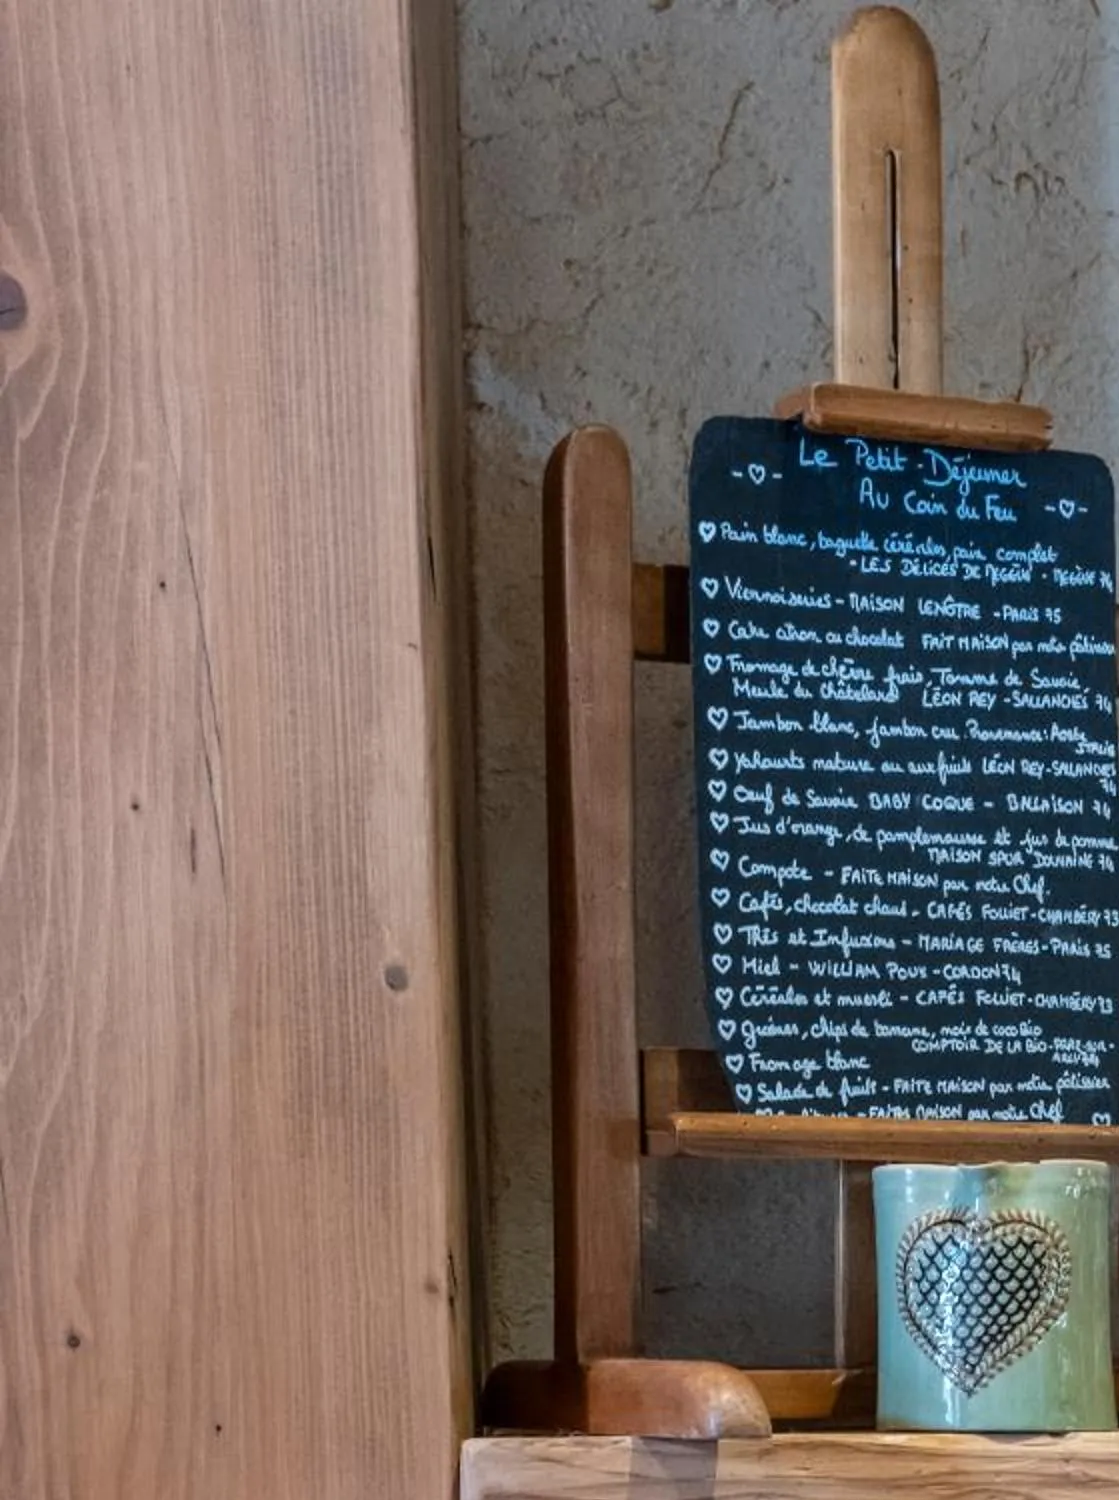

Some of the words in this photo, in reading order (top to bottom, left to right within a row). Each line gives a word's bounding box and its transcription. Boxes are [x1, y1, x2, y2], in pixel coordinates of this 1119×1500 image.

[799, 436, 839, 467] Le
[859, 476, 890, 509] Au
[903, 489, 947, 515] Coin
[956, 496, 980, 520] du
[985, 494, 1017, 522] Feu
[720, 520, 758, 543] Pain
[817, 530, 879, 557] baguette
[996, 541, 1060, 571] complet
[962, 563, 981, 580] DE
[723, 575, 832, 610] Viennoiseries
[849, 592, 905, 615] MAISON
[918, 594, 982, 621] LENÔTRE
[1044, 607, 1062, 625] 75
[728, 620, 770, 640] Cake
[825, 631, 844, 644] ou
[845, 625, 905, 649] chocolat
[921, 632, 955, 651] FAIT
[957, 632, 1009, 651] MAISON
[1011, 640, 1034, 660] par
[726, 653, 799, 685] Fromage
[802, 658, 820, 678] de
[930, 667, 999, 687] Tomme
[1004, 668, 1023, 686] de
[731, 676, 789, 700] Meule
[793, 681, 813, 699] du
[819, 680, 900, 704] Châtelard
[921, 687, 962, 709] LÉON
[969, 691, 997, 712] REY
[1095, 692, 1113, 715] 74
[733, 710, 804, 732] Jambon
[865, 715, 928, 749] jambon
[812, 751, 876, 773] nature
[880, 762, 905, 774] ou
[981, 752, 1015, 775] LÉON
[781, 786, 801, 806] de
[805, 787, 859, 810] Savoie
[868, 791, 911, 811] BABY
[921, 793, 975, 812] COQUE
[1005, 793, 1084, 815] BALLAISON
[1091, 799, 1111, 820] 74
[732, 815, 771, 835] Jus
[875, 825, 988, 853] pamplemousse
[993, 825, 1012, 846] et
[1019, 827, 1049, 854] jus
[1070, 836, 1119, 858] pomme
[927, 847, 983, 866] MAISON
[737, 854, 813, 889] Compote
[840, 865, 885, 886] FAITE
[887, 867, 939, 889] MAISON
[942, 878, 970, 899] par
[974, 876, 1011, 895] notre
[793, 892, 860, 916] chocolat
[863, 893, 908, 918] chaud
[926, 900, 973, 922] CAFÉS
[787, 927, 807, 946] et
[808, 925, 897, 959] Infusions
[917, 932, 985, 954] MARIAGE
[741, 953, 781, 976] Miel
[807, 959, 881, 981] WILLIAM
[738, 983, 809, 1008] Céréales
[813, 986, 832, 1007] et
[836, 988, 894, 1008] muesli
[914, 983, 965, 1006] CAFÉS
[810, 1014, 849, 1043] chips
[850, 1017, 869, 1038] de
[974, 1017, 990, 1037] de
[991, 1025, 1019, 1038] coco
[911, 1034, 981, 1054] COMPTOIR
[983, 1038, 1004, 1055] DE
[1007, 1040, 1023, 1054] LA
[748, 1053, 822, 1080] Fromage
[825, 1049, 871, 1070] blanc
[756, 1080, 814, 1102] Salade
[815, 1080, 833, 1098] de
[893, 1076, 934, 1096] FAITE
[936, 1076, 986, 1095] MAISON
[988, 1083, 1014, 1100] par
[1055, 1070, 1111, 1095] pâtissier
[1029, 1099, 1065, 1124] Chef
